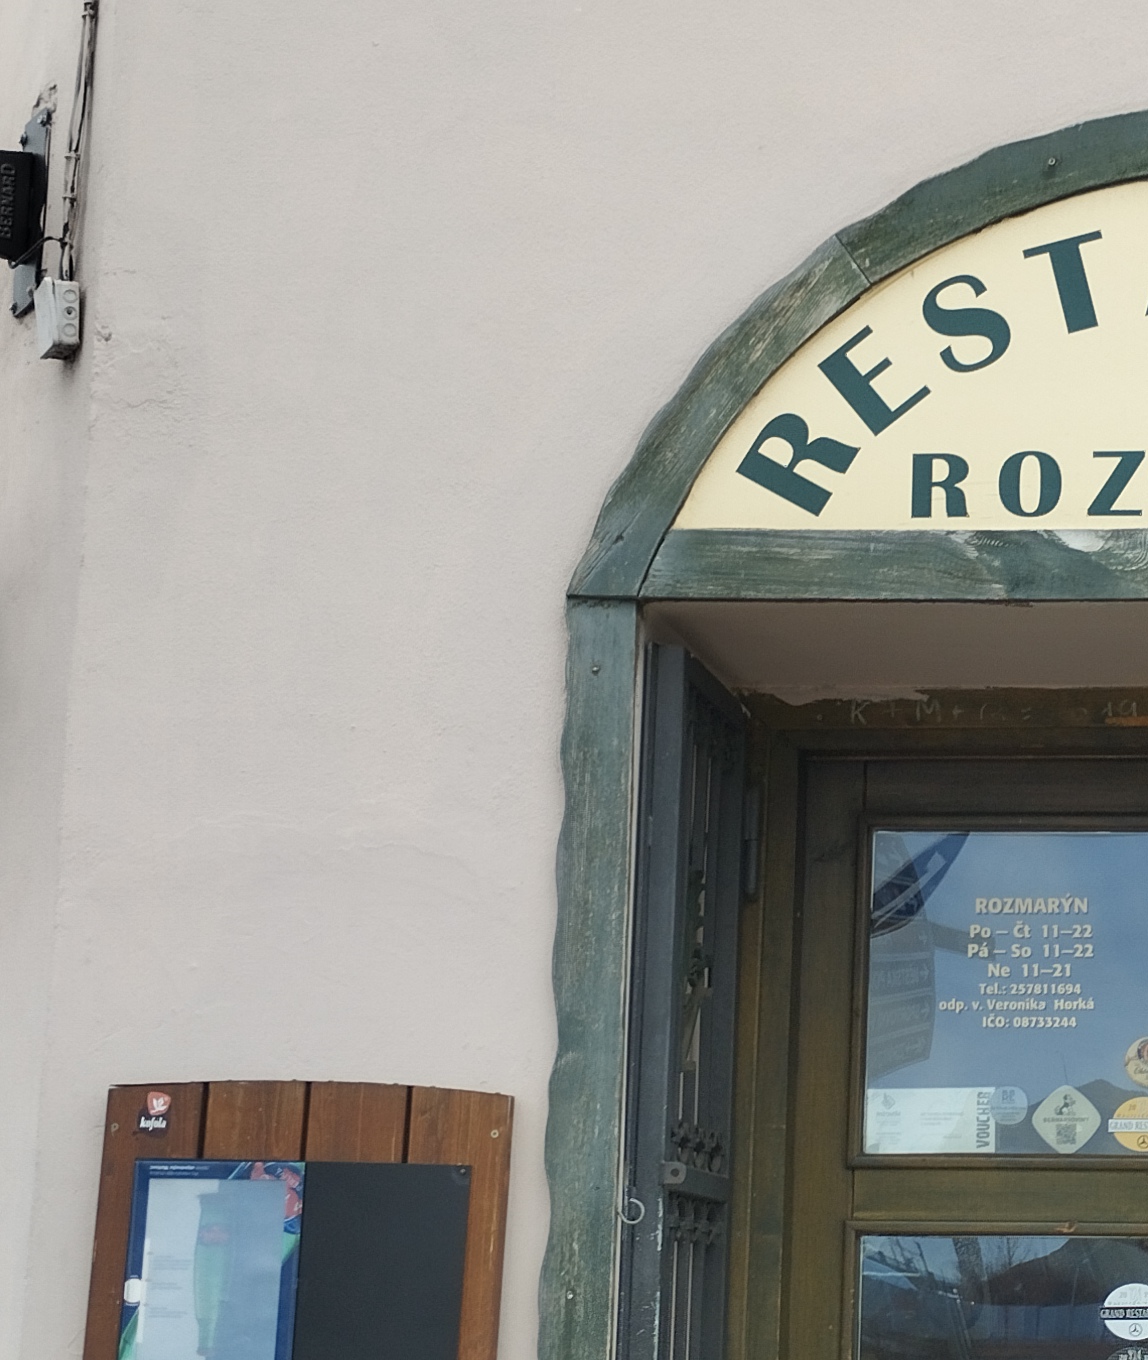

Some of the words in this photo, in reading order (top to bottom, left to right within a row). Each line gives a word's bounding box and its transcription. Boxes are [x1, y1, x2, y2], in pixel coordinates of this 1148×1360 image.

[975, 893, 1088, 914] ROZMARÝN
[969, 924, 991, 938] Po
[1013, 921, 1031, 938] Čt
[967, 942, 989, 958] Pá
[1011, 943, 1031, 958] So
[987, 963, 1011, 977] Ne
[1010, 983, 1082, 995] 257811694
[938, 998, 968, 1013] odp.
[987, 998, 1046, 1011] Veronika
[1053, 997, 1095, 1011] Horká
[982, 1014, 1010, 1028] IČO:
[1013, 1016, 1077, 1028] 08733244
[139, 1116, 167, 1131] kofola
[976, 1091, 991, 1149] VOUCHER
[1109, 1121, 1132, 1130] GRAND
[1100, 1309, 1125, 1318] GRAND
